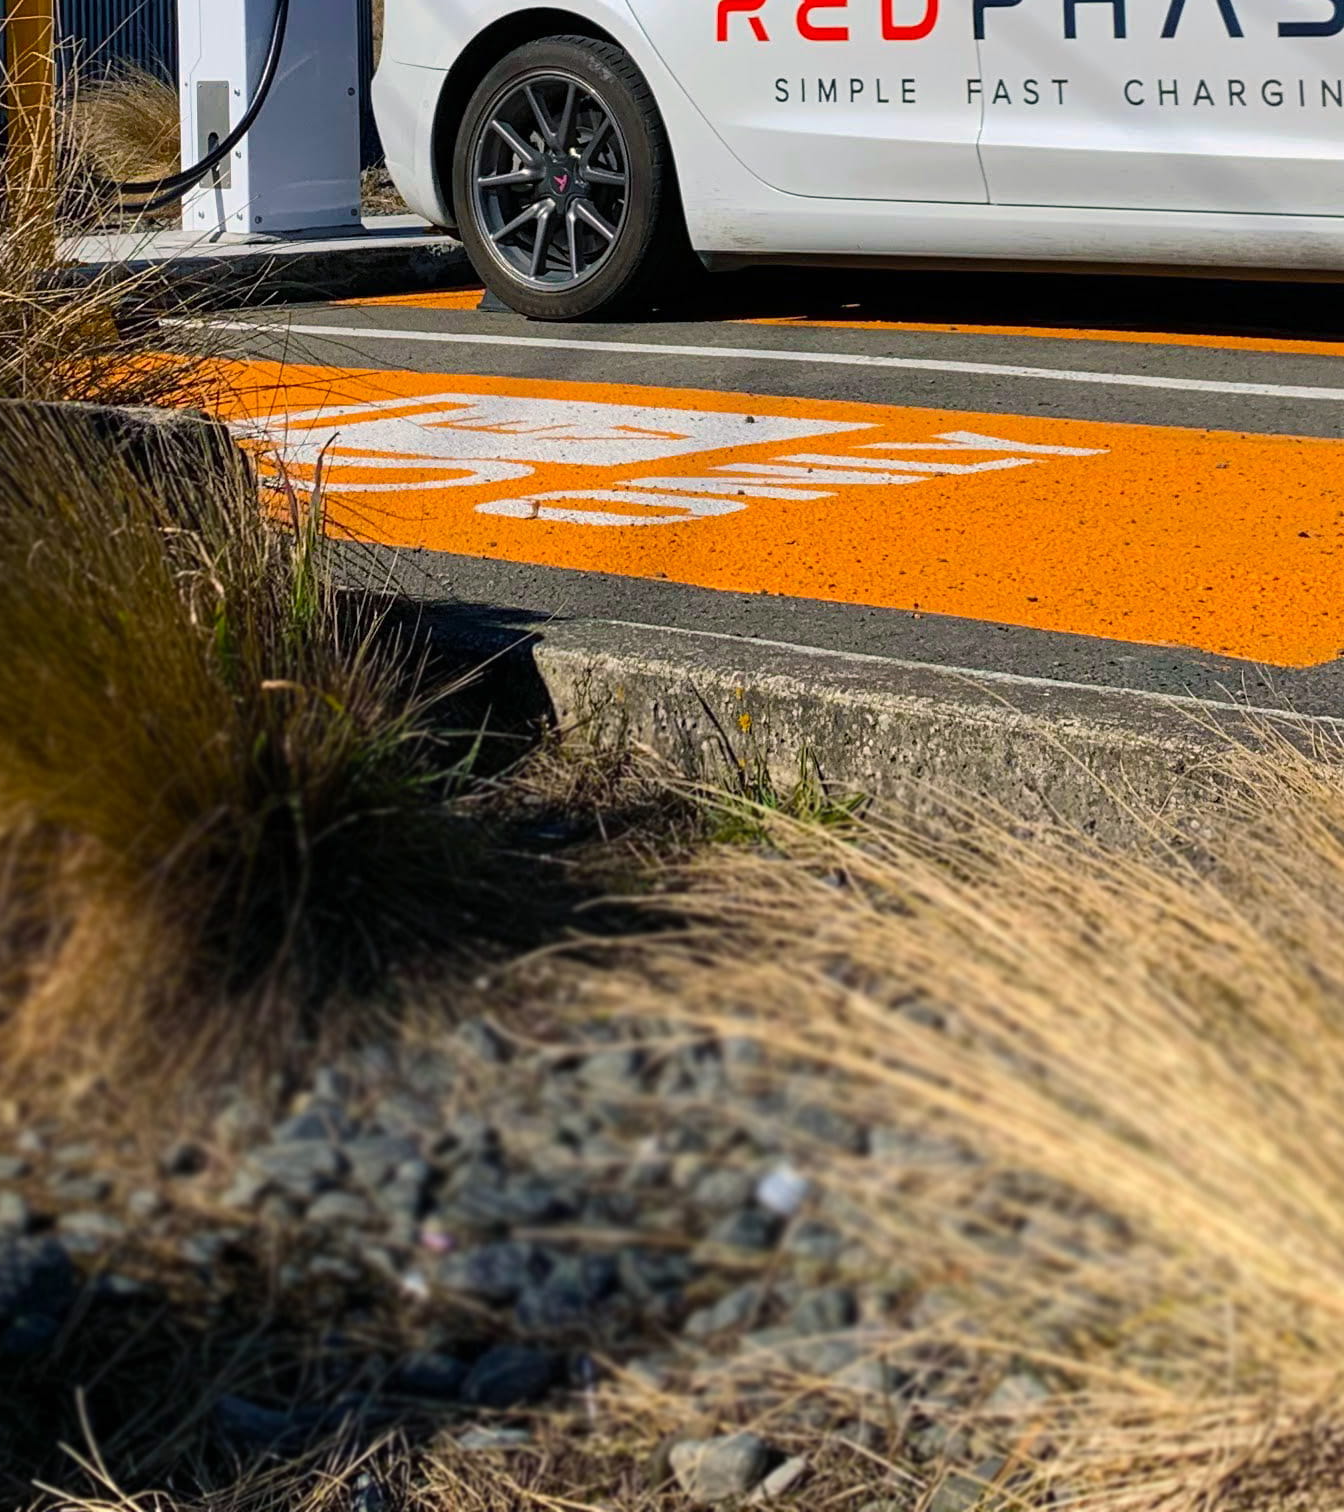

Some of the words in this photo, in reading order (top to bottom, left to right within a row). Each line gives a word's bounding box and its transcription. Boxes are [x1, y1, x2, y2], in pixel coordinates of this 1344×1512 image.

[774, 78, 918, 105] SIMPLE
[967, 78, 1069, 106] FAST
[474, 431, 1111, 527] ONLY
